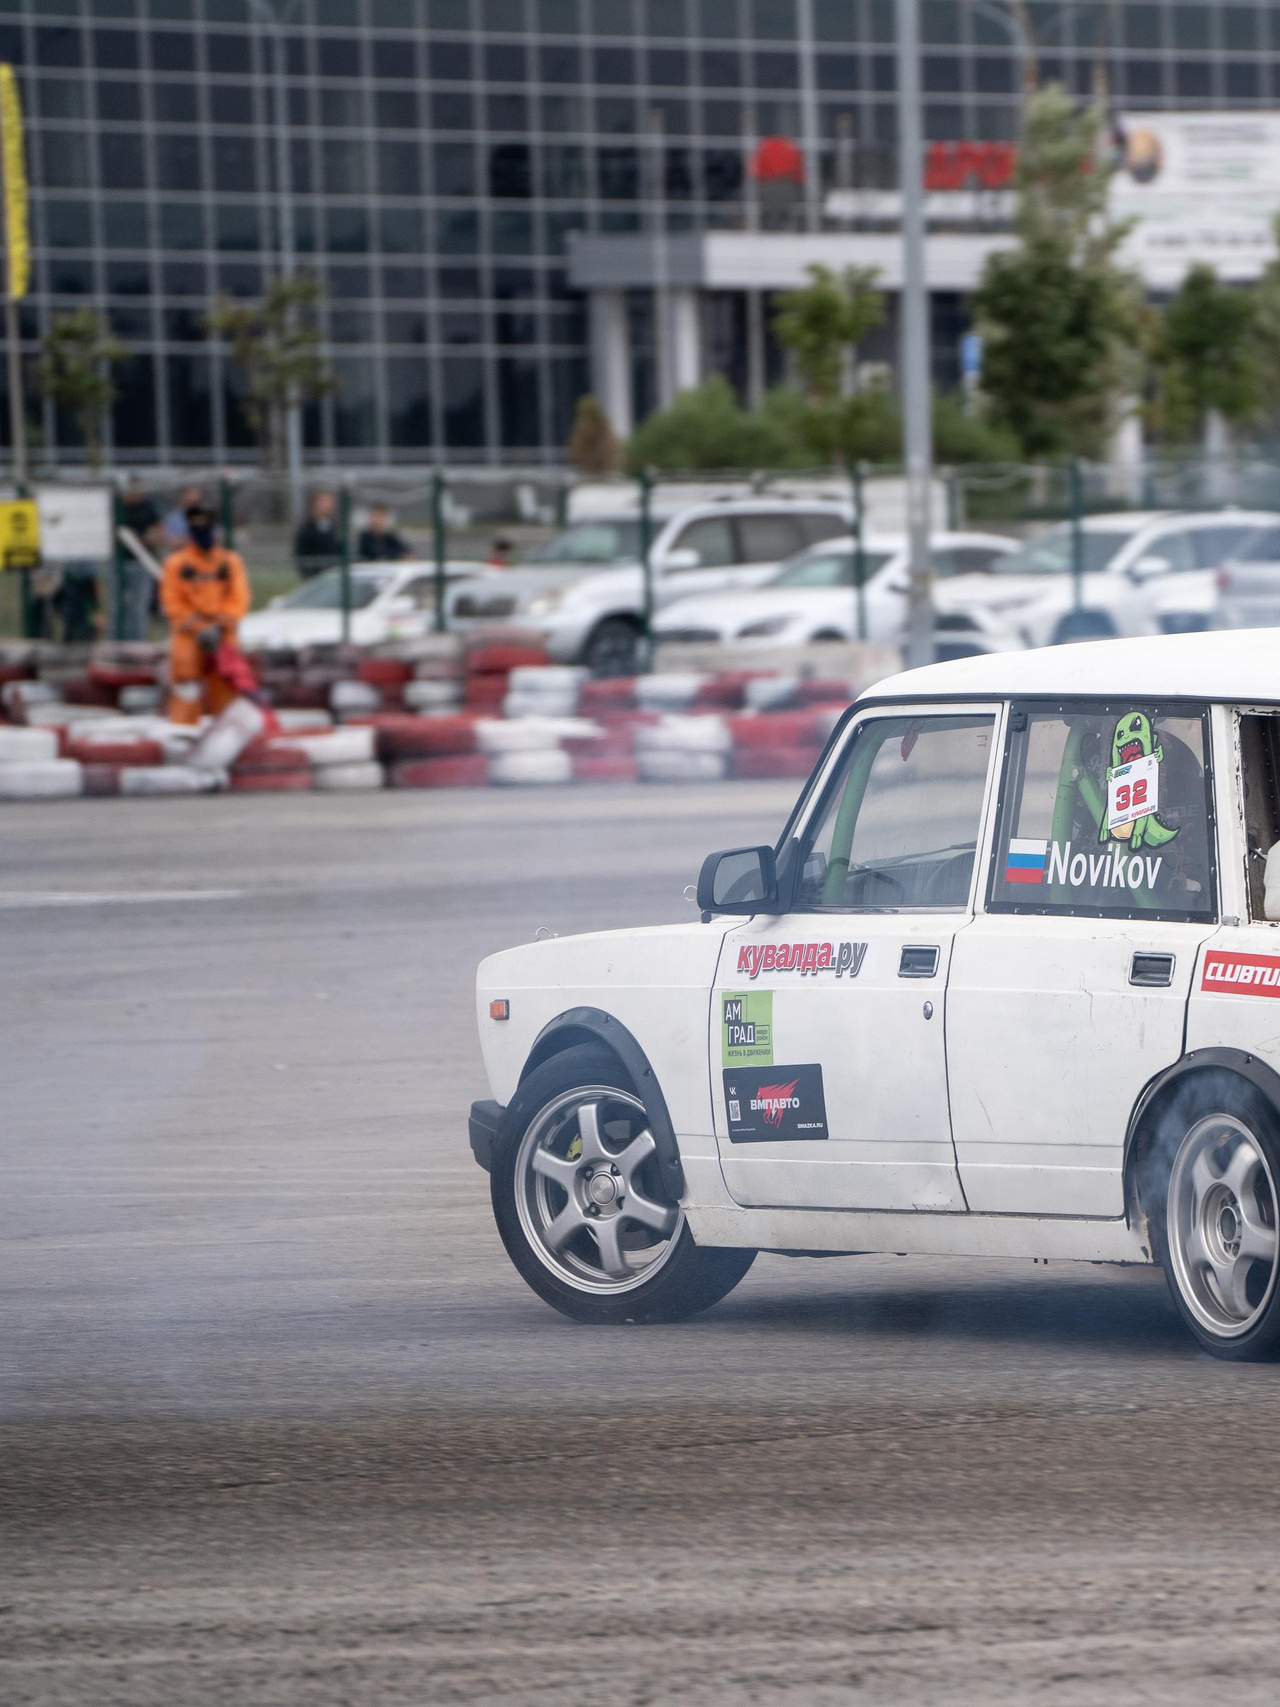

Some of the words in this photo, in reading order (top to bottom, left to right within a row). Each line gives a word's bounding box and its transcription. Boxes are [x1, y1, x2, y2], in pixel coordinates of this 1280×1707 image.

[1116, 779, 1147, 811] 32
[1047, 841, 1162, 889] Novikov
[737, 942, 868, 979] кувалда.ру
[725, 1002, 741, 1021] АМ
[728, 1025, 754, 1044] ГРАД
[750, 1097, 800, 1112] ВМПАВТО
